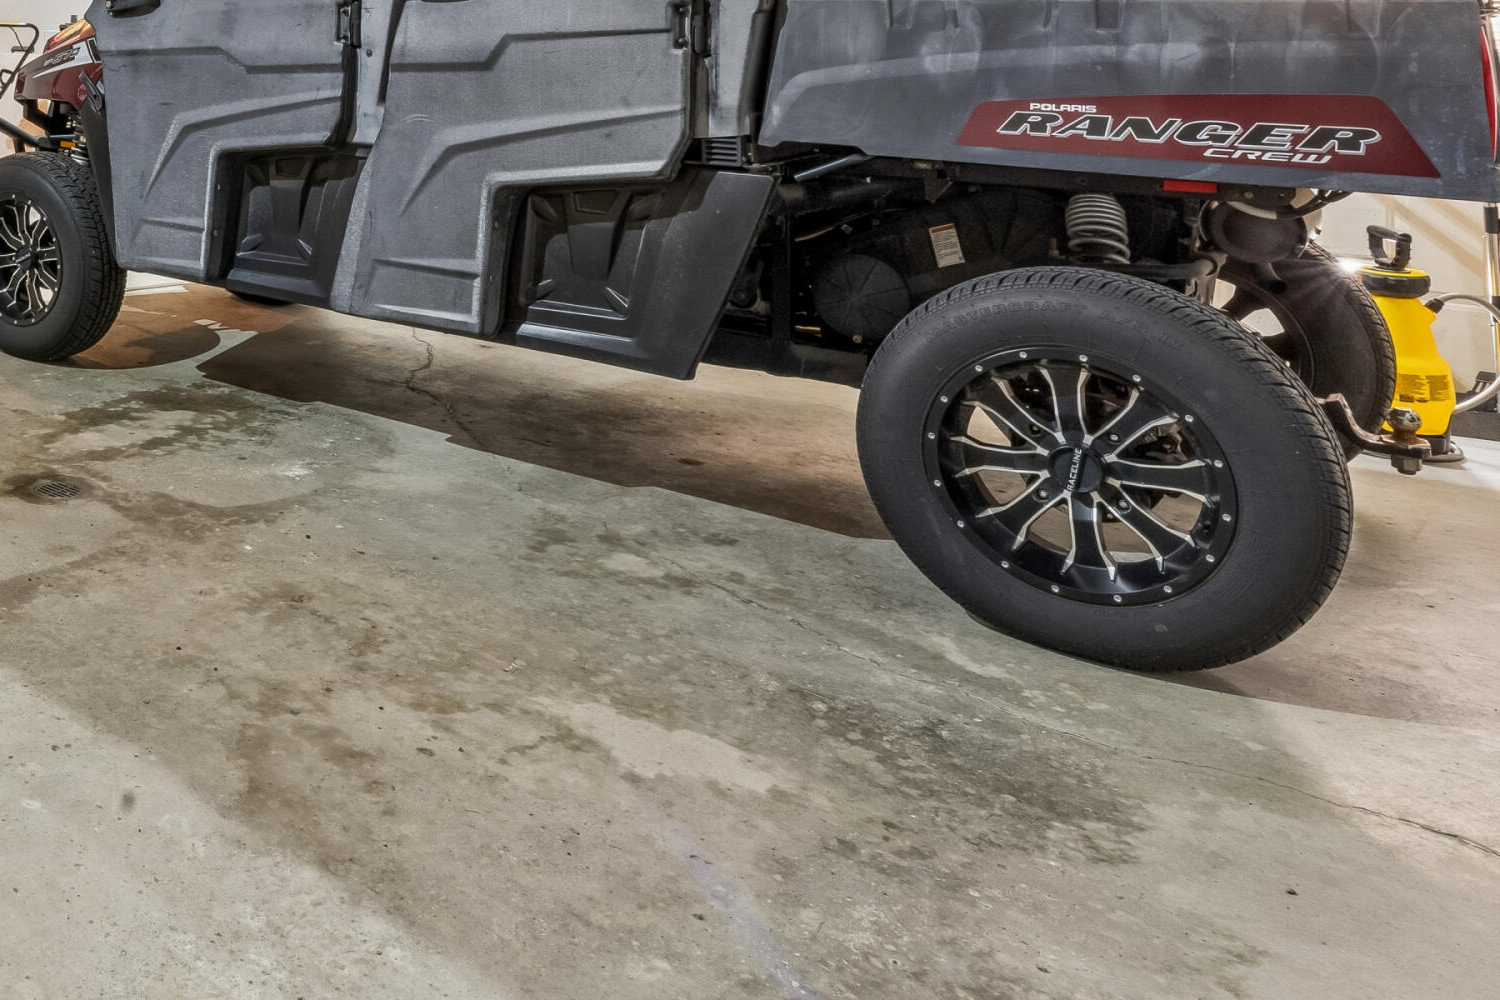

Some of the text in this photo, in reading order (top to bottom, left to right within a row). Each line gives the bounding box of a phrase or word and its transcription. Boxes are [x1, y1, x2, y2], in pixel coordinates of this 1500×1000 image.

[1030, 103, 1097, 113] POLARIS
[996, 111, 1382, 155] RANGER
[1202, 148, 1332, 164] CREW
[1067, 448, 1082, 491] RACELINE
